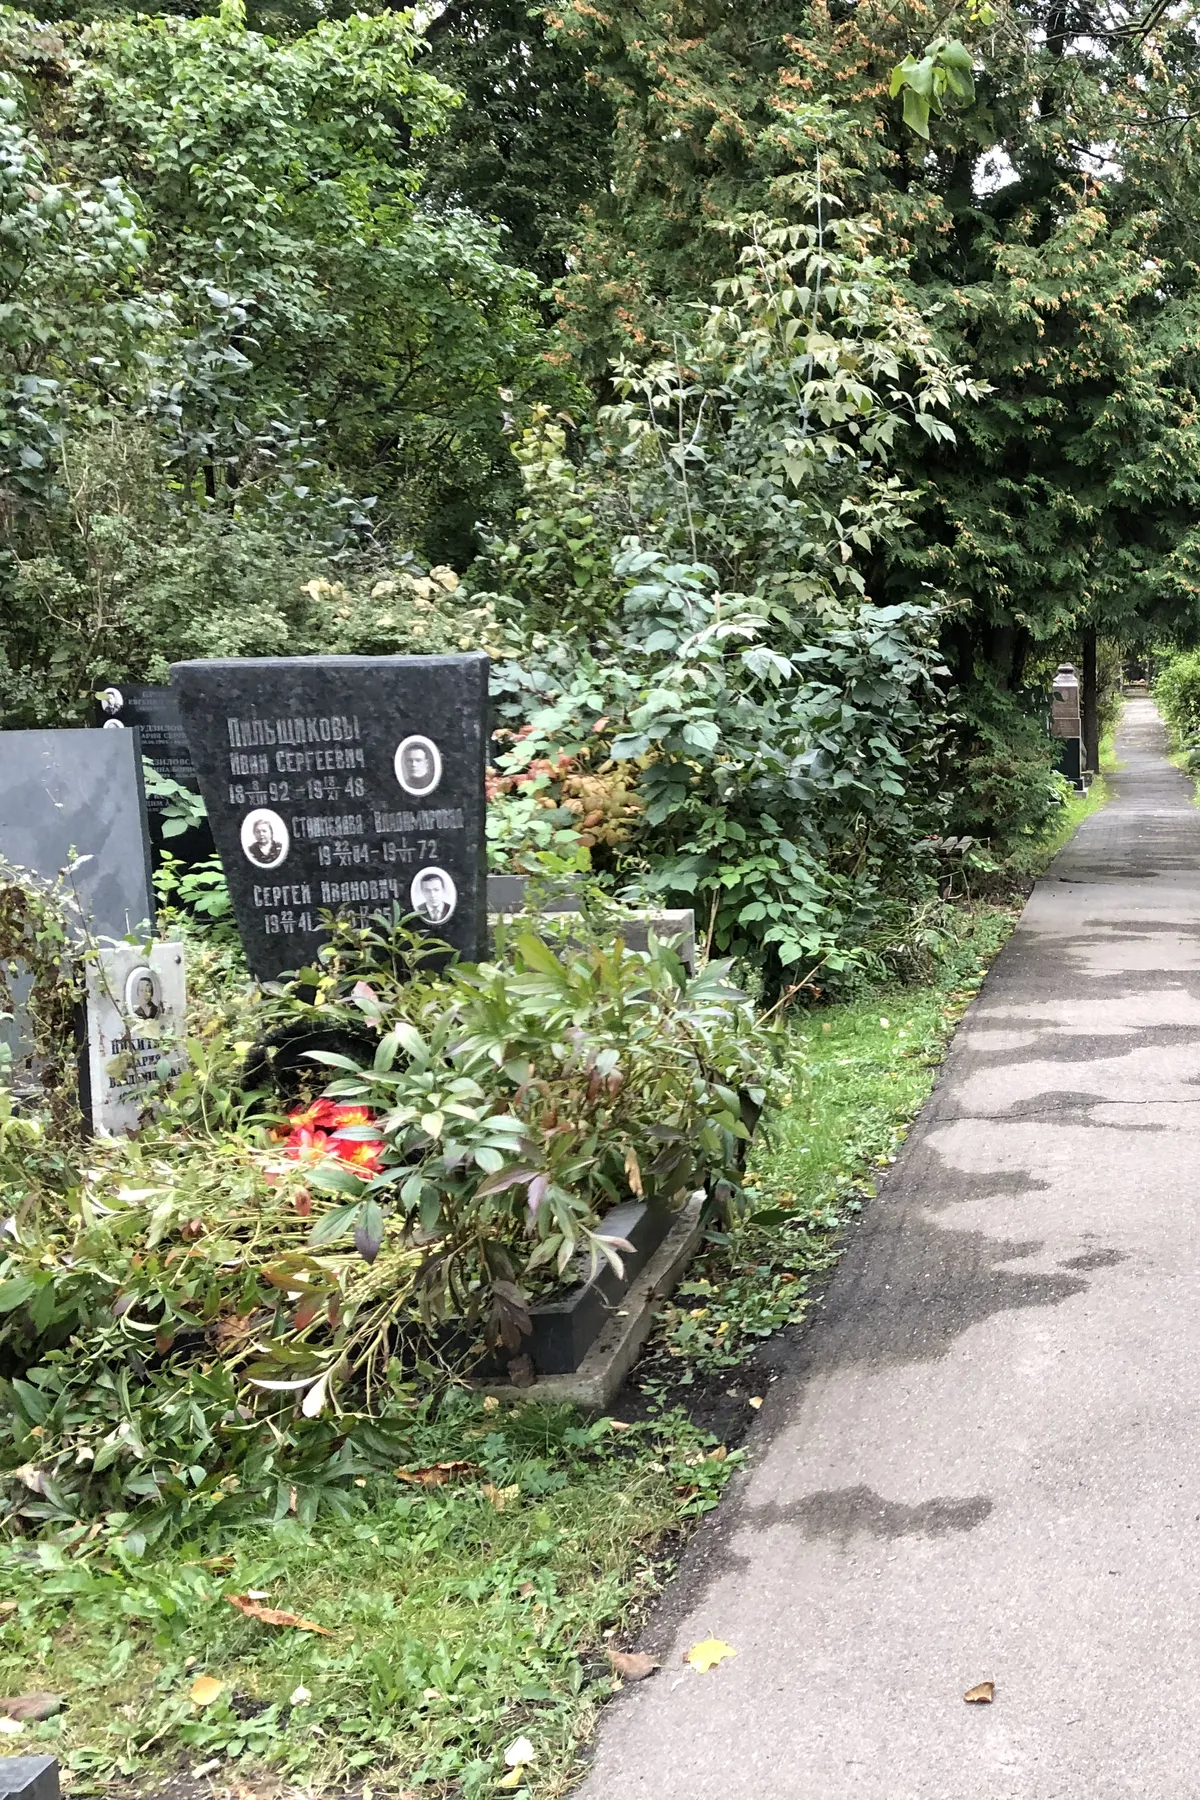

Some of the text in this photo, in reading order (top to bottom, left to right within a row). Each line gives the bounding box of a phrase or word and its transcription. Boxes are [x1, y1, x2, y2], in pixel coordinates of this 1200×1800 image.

[227, 714, 361, 748] ПИЛЬЩИКОВЫ
[229, 748, 365, 776] ИВАН СЕРГЕЕВИЧ
[253, 878, 399, 907] СЕРГЕЙ ИВАНОВИЧ
